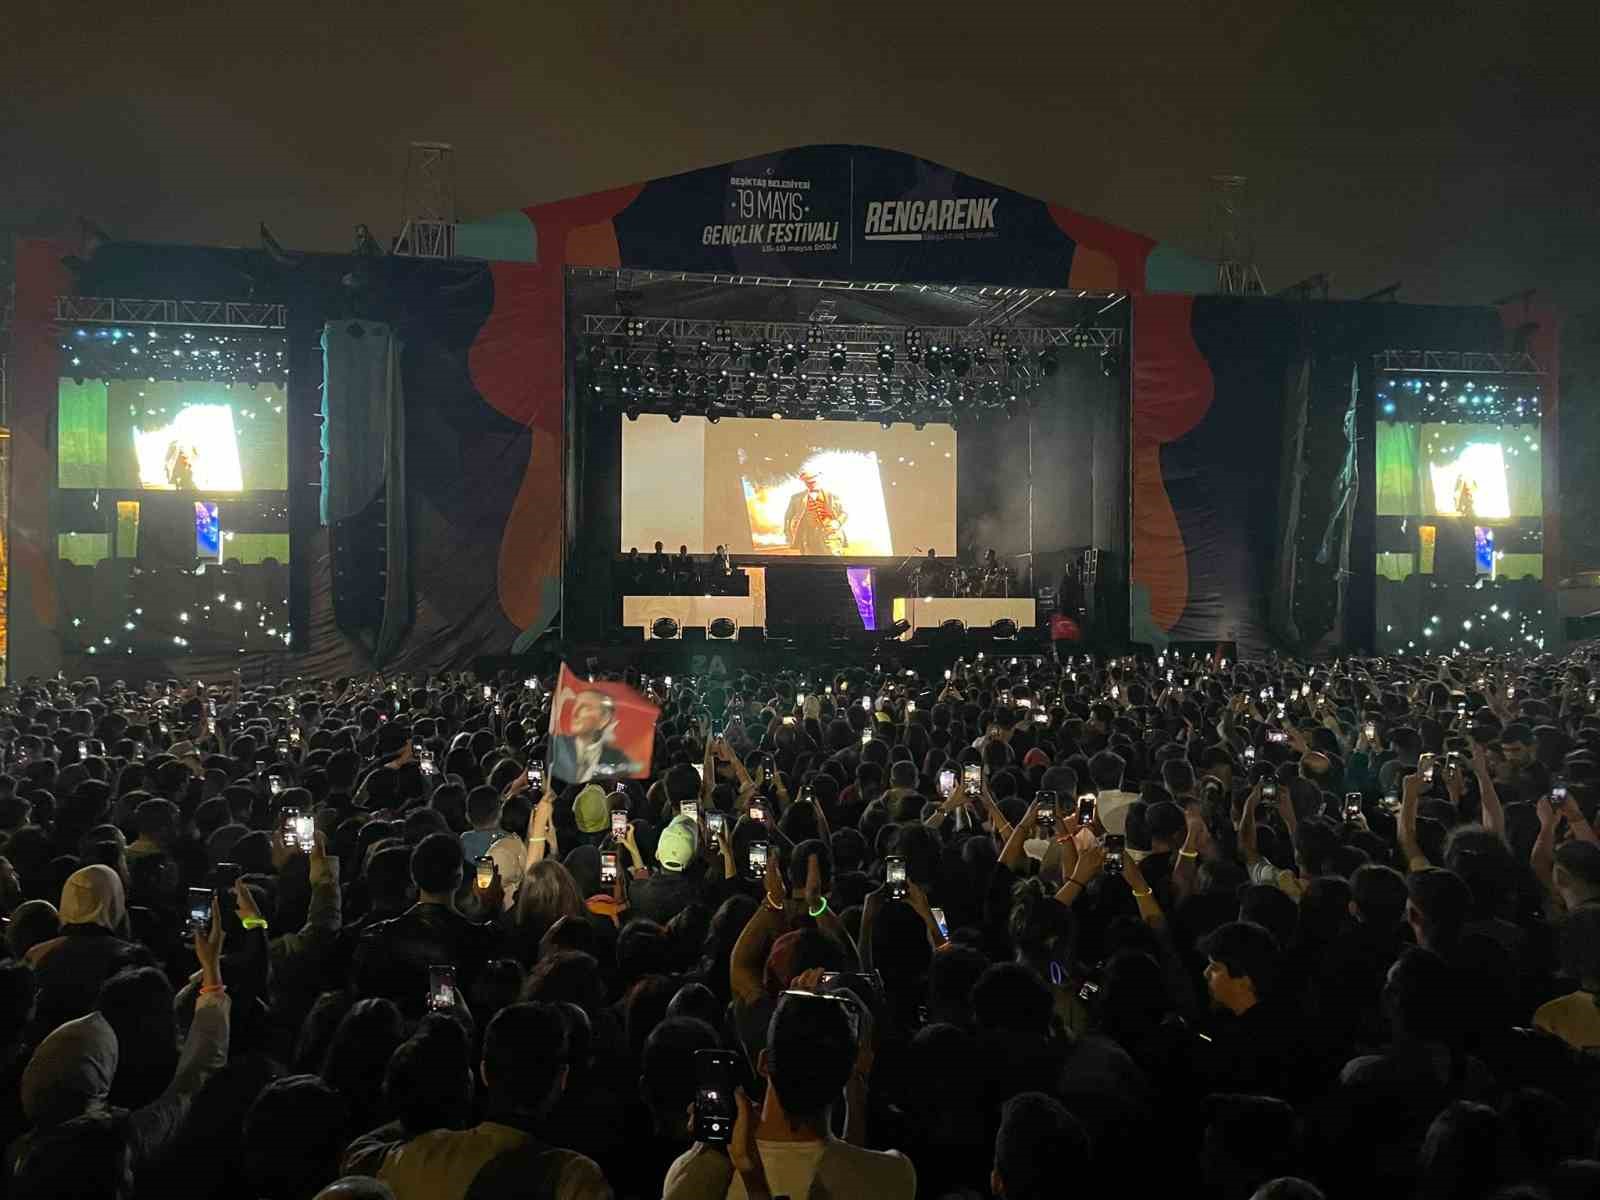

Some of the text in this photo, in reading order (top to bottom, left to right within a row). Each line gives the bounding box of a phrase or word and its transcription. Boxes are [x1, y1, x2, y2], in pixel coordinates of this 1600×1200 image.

[736, 189, 803, 221] 19 MAYIS
[864, 198, 999, 233] RENGARENK
[702, 221, 840, 246] GENÇLİK FESTİVALİ
